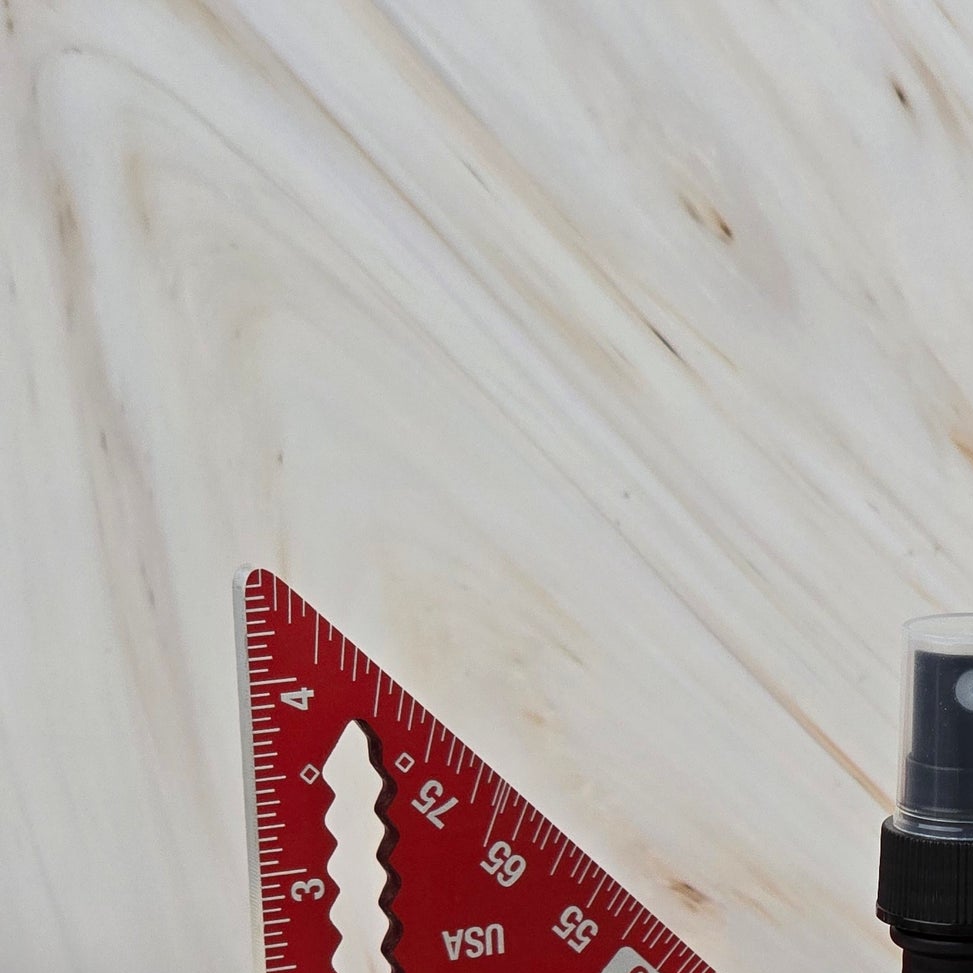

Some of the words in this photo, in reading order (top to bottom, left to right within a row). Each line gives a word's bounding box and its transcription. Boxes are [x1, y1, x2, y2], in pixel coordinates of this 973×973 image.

[280, 686, 314, 711] 4
[411, 779, 459, 830] 75
[480, 840, 527, 888] 65
[291, 877, 325, 903] 3
[441, 923, 505, 961] USA
[552, 905, 599, 954] 55
